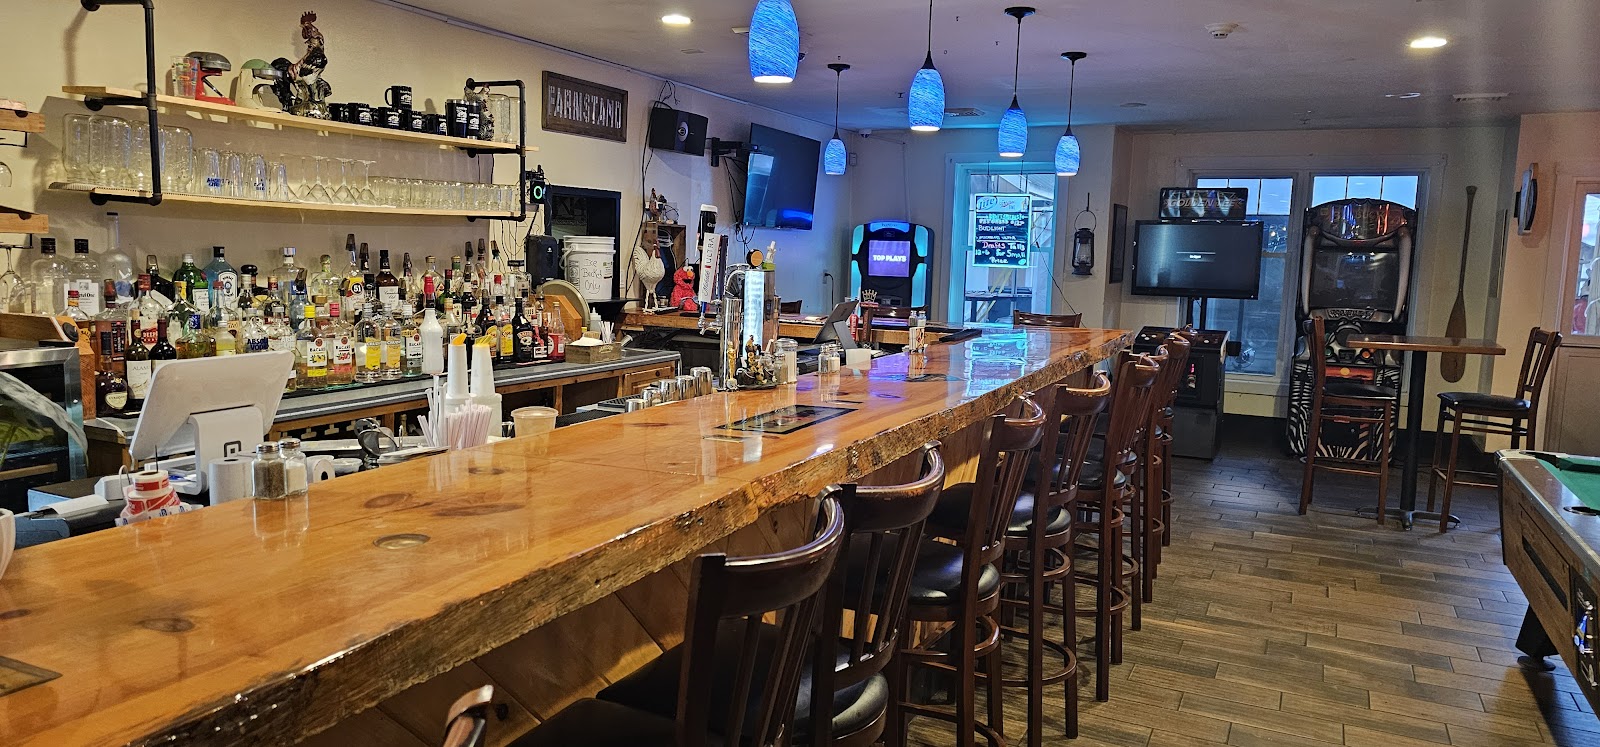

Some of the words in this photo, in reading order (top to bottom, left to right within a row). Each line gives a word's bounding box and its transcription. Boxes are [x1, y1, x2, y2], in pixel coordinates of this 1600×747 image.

[1169, 198, 1214, 208] GOLDEN
[706, 237, 715, 264] ULTRA
[873, 254, 885, 262] TOP
[885, 255, 907, 263] PLAYS
